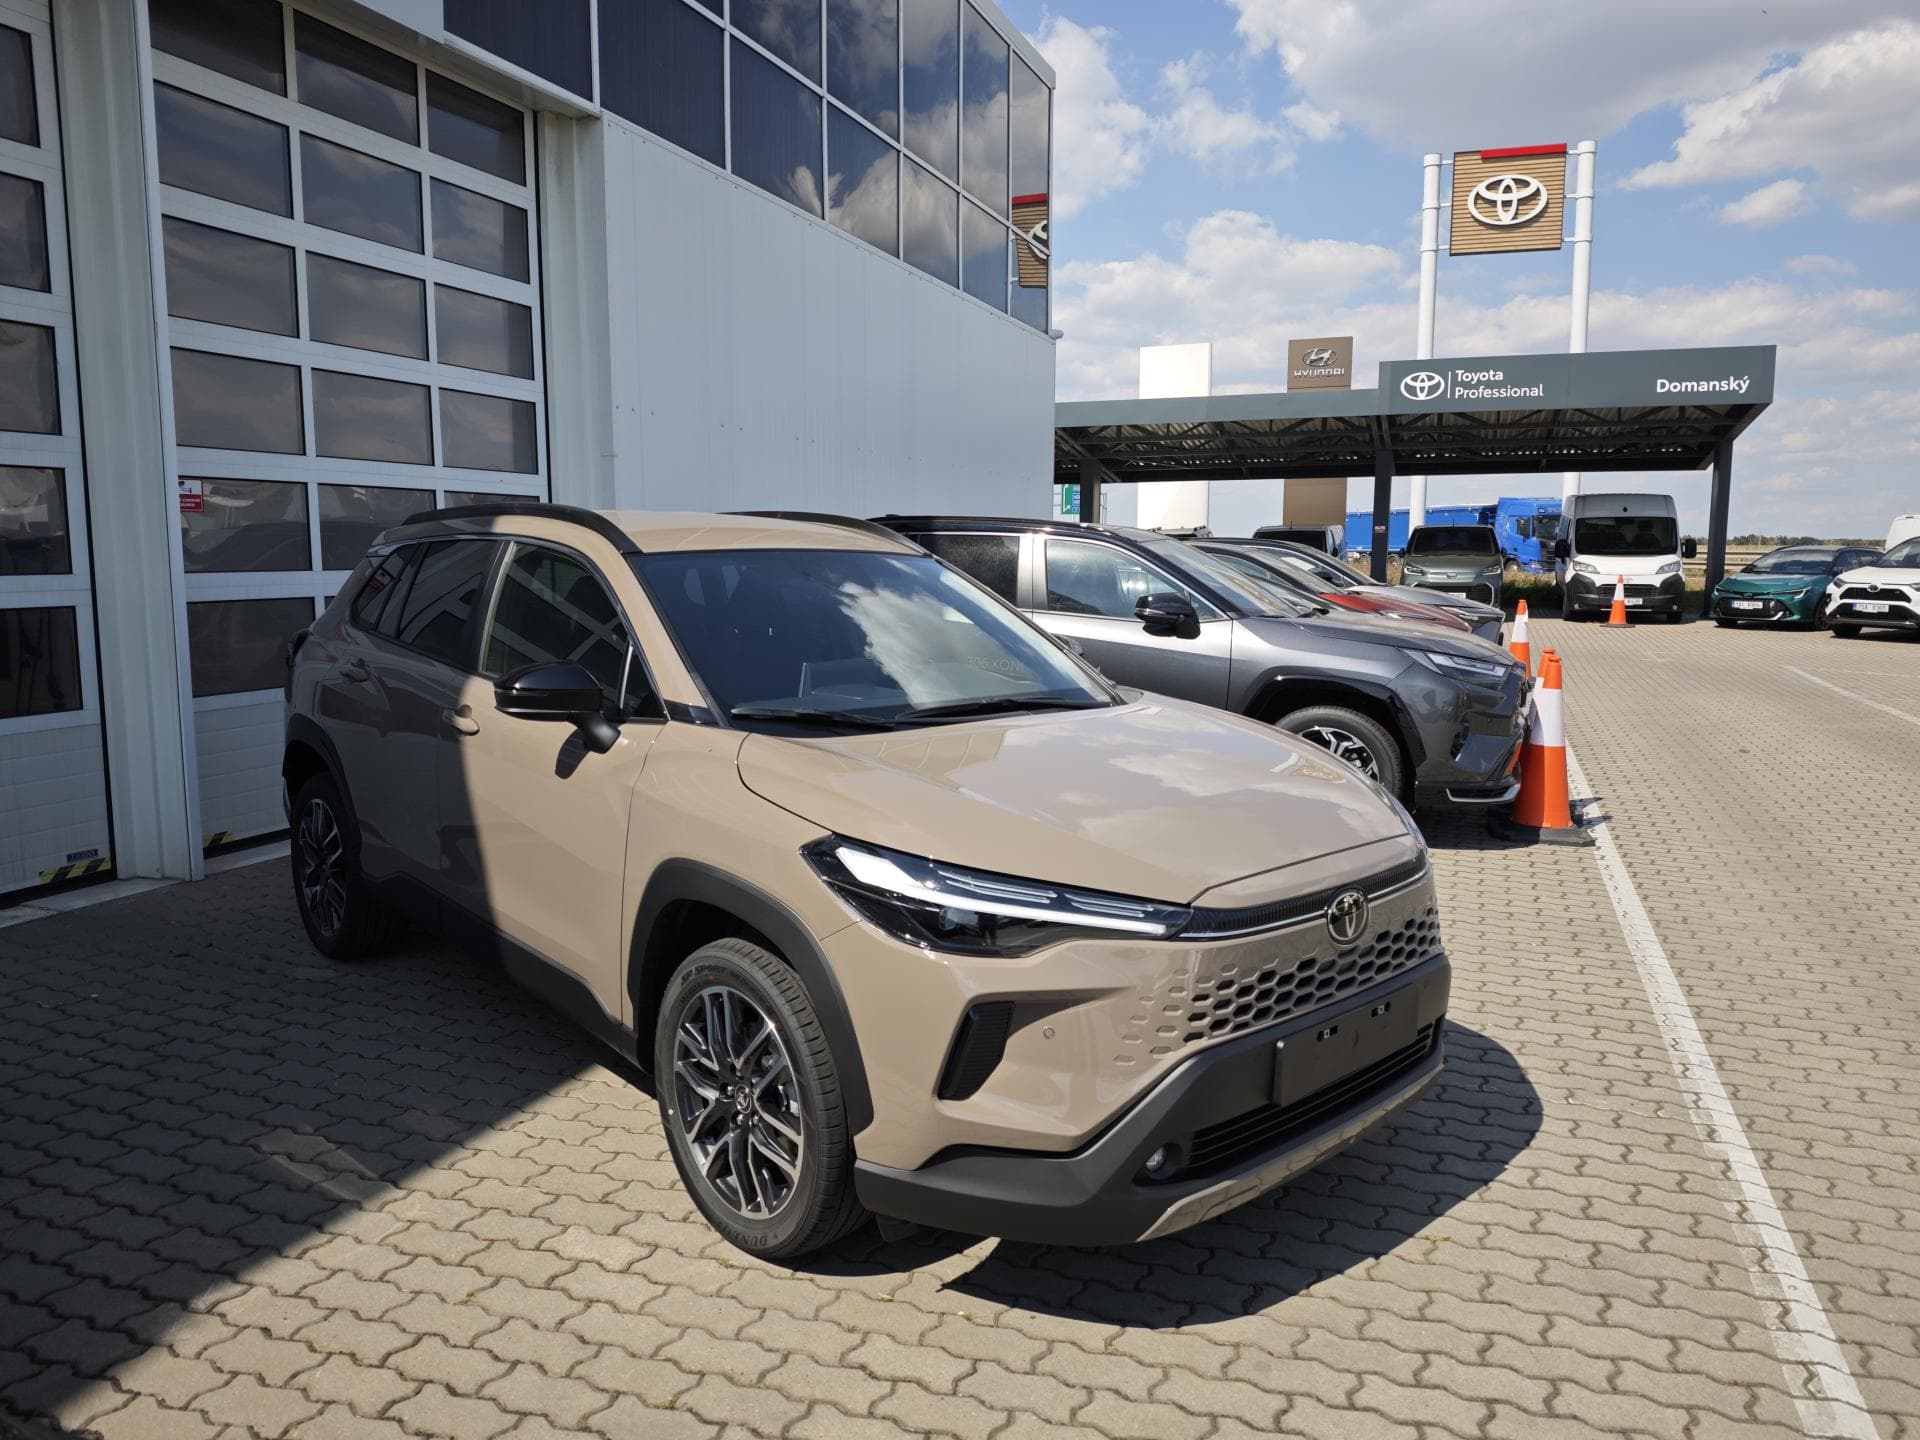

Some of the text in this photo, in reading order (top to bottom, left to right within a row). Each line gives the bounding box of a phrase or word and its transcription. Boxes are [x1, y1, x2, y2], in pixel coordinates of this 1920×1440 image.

[1455, 369, 1504, 384] Toyota
[1656, 375, 1750, 394] Domanský
[1455, 383, 1544, 399] Professional
